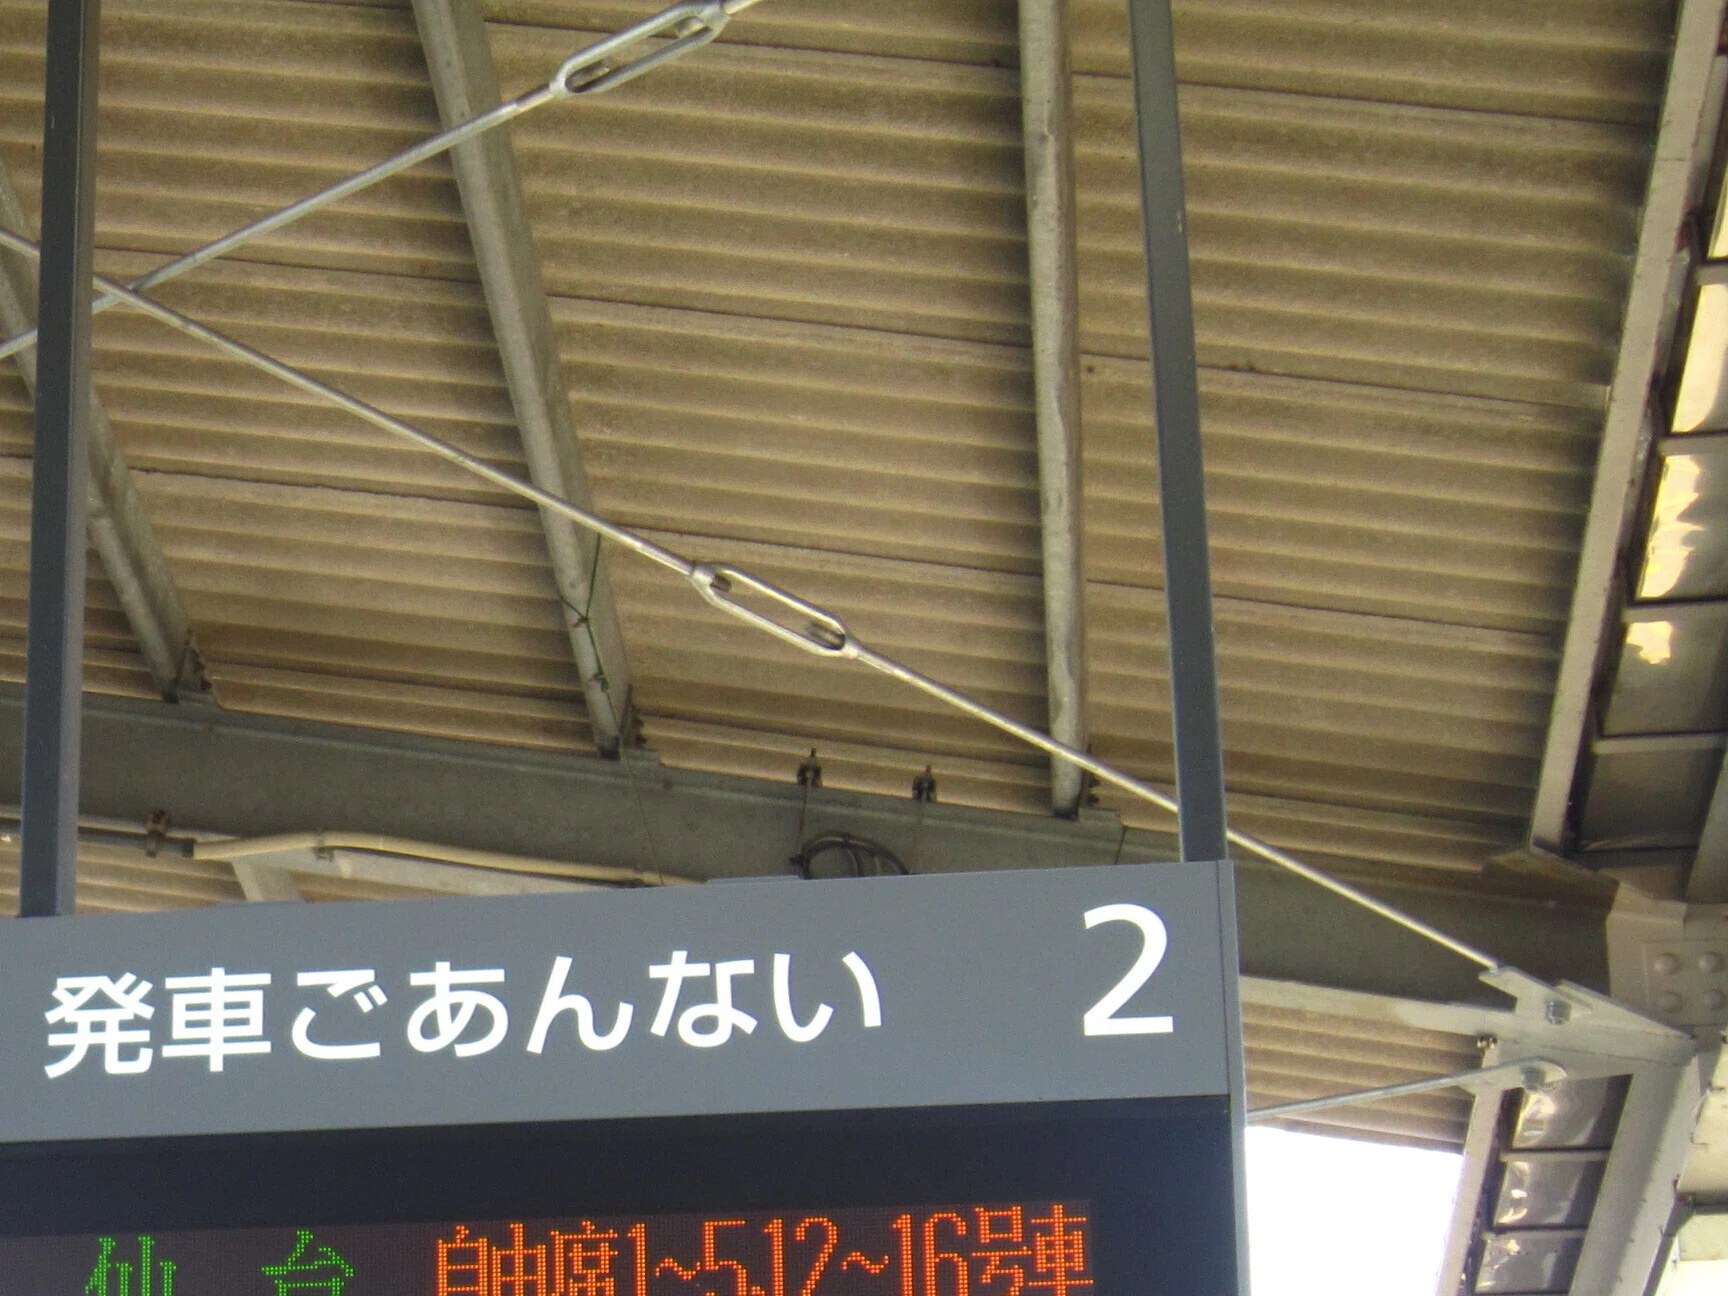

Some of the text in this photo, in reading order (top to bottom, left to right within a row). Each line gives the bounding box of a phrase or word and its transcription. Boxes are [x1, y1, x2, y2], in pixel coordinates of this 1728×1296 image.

[45, 949, 883, 1078] 発車ごあんない
[1080, 903, 1176, 1037] 2
